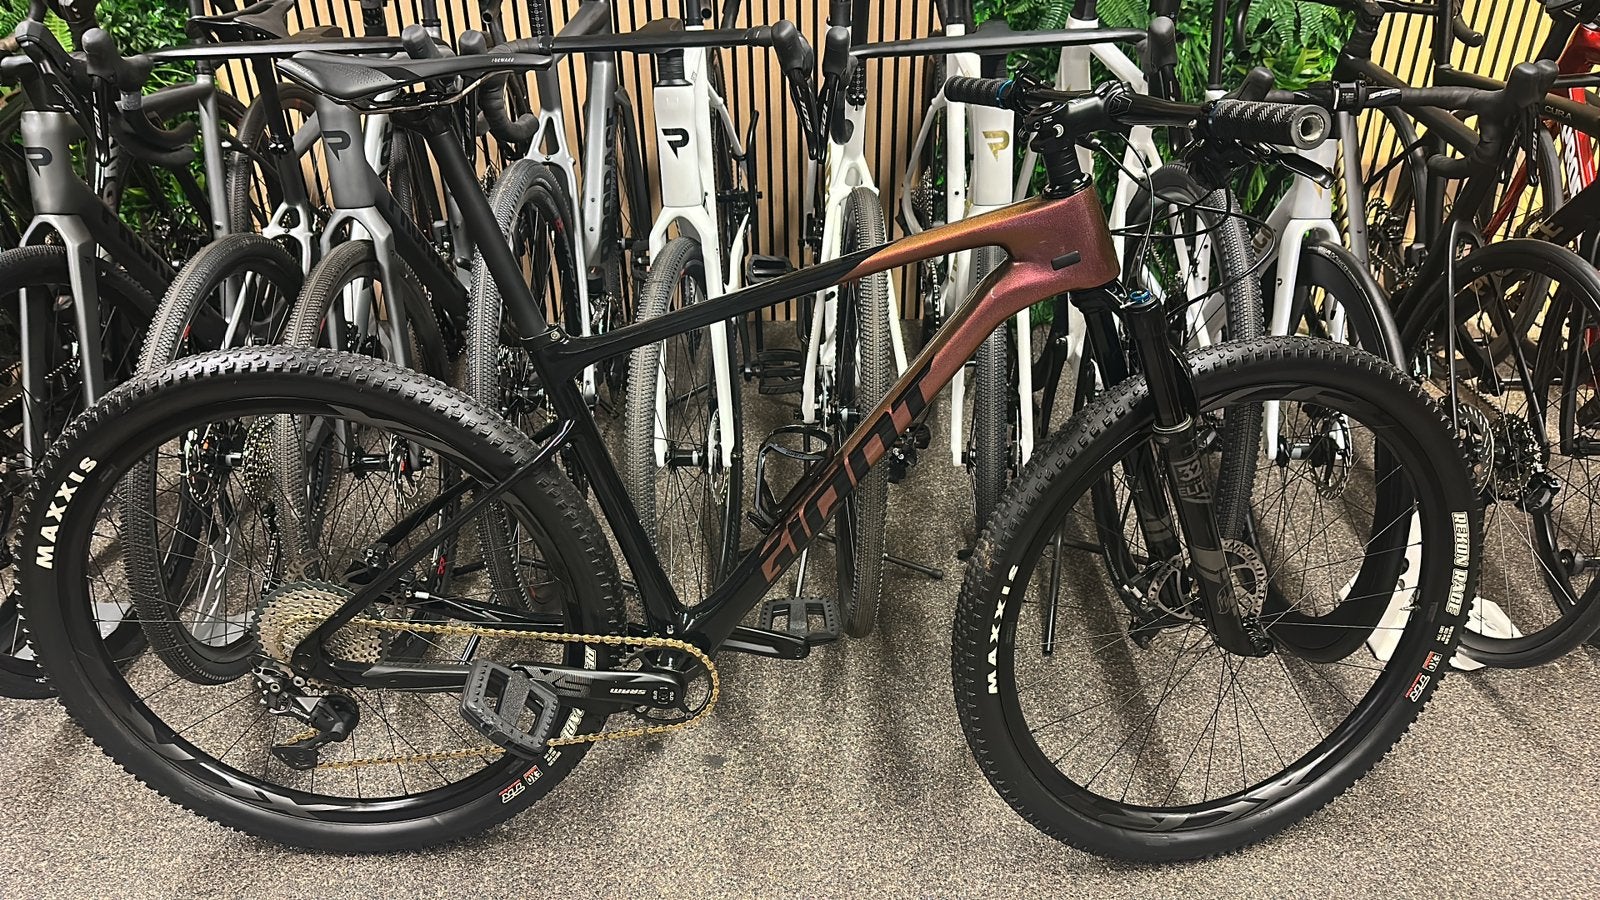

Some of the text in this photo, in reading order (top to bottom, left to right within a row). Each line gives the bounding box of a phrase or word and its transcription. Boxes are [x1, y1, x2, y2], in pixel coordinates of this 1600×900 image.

[36, 456, 98, 570] MAXXIS
[1451, 511, 1470, 568] REKON
[987, 564, 1019, 694] MAXXIS
[1445, 568, 1469, 616] RACE
